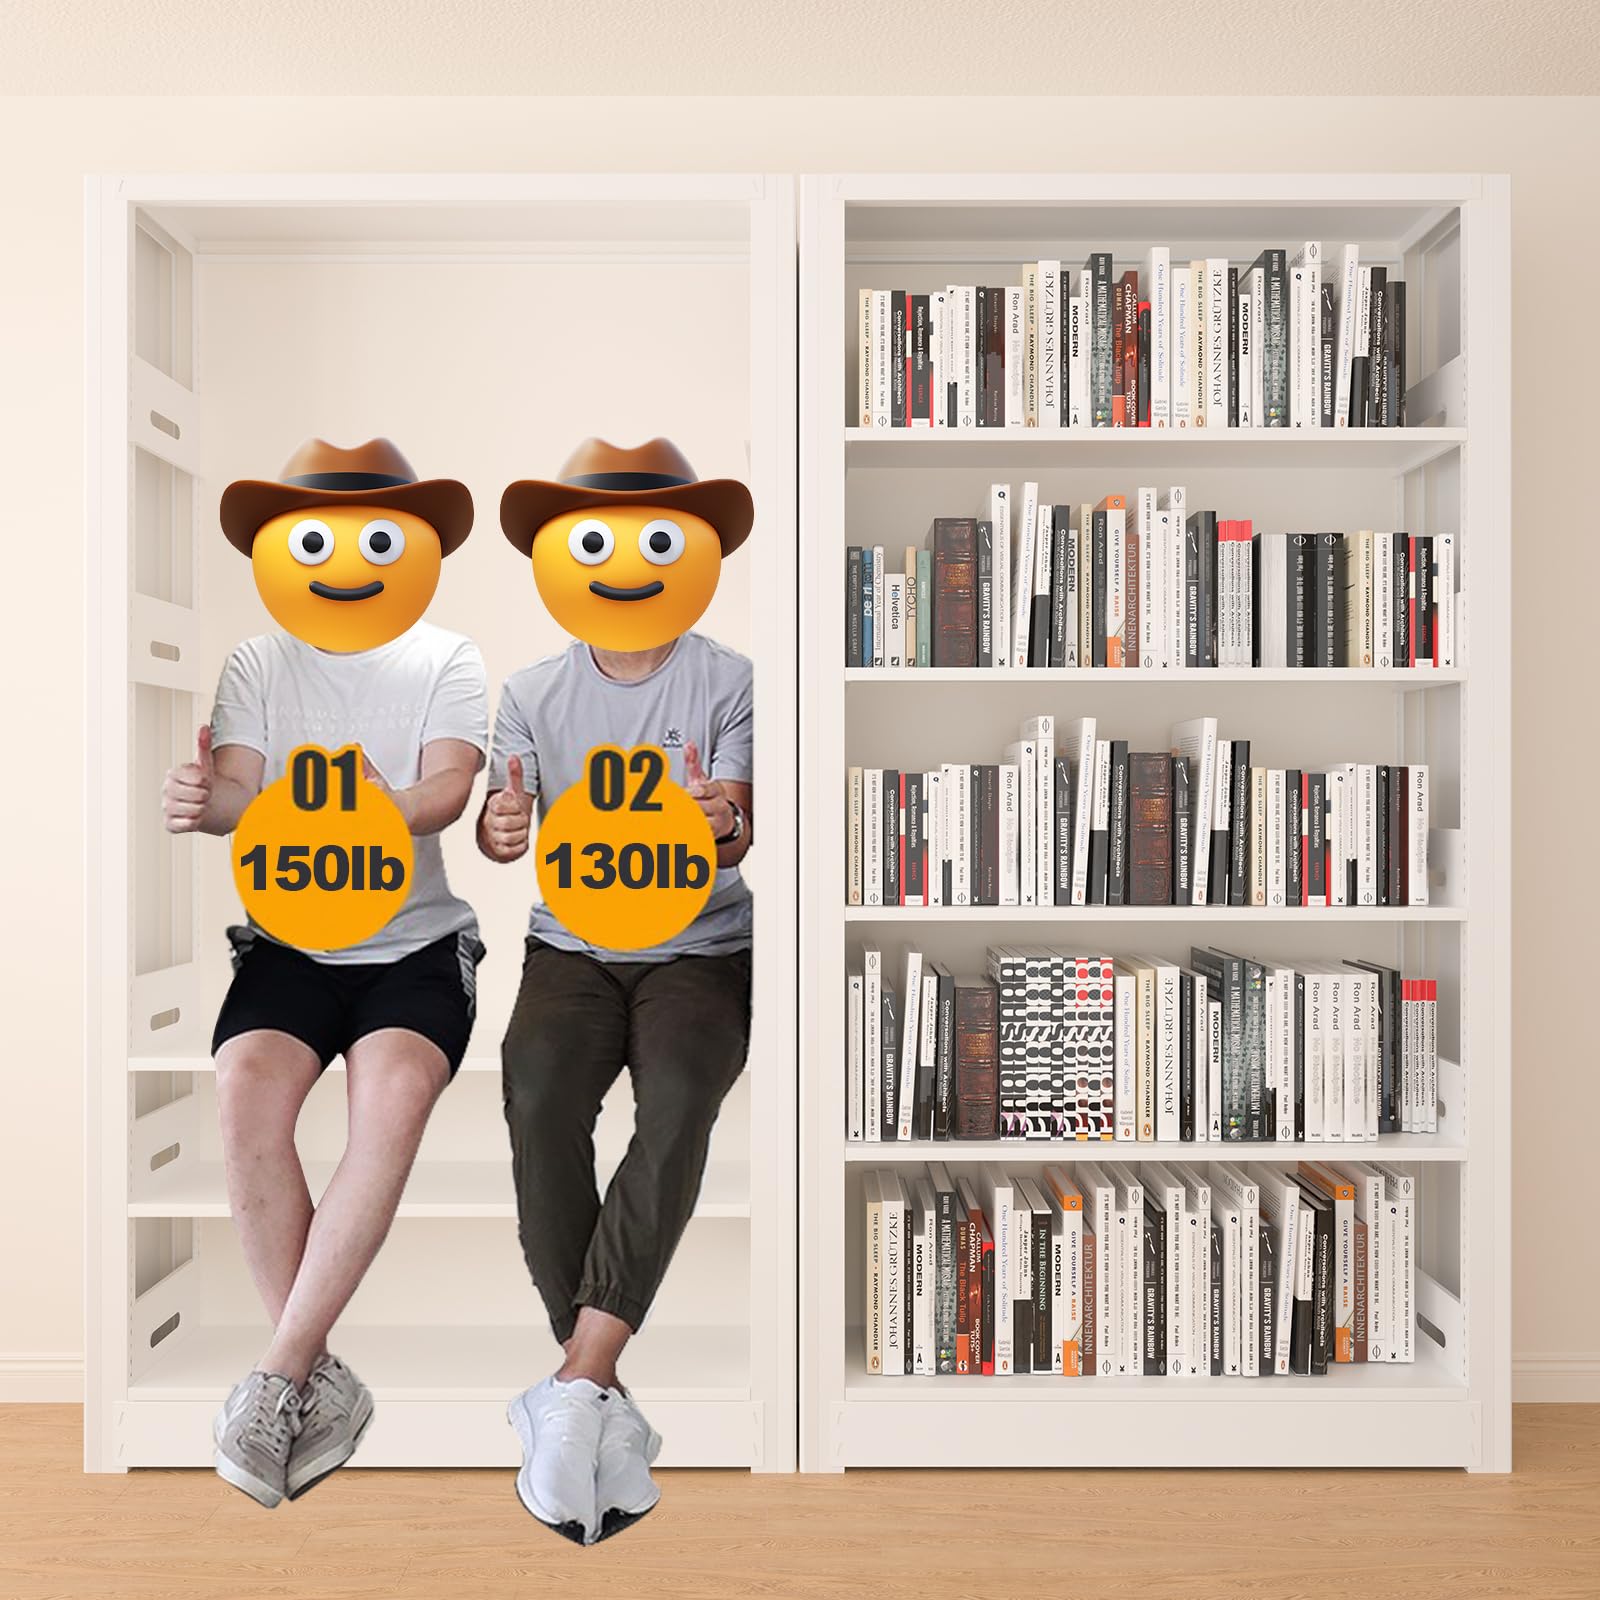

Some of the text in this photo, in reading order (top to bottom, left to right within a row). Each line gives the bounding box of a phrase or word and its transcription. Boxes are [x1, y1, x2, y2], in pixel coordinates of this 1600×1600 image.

[1012, 292, 1020, 334] Ron Arad
[1044, 272, 1055, 409] JOHANNES GRÜTZKE
[1157, 340, 1164, 350] of
[1212, 270, 1222, 408] JOHANNES GRÜTZKE
[1114, 323, 1123, 384] The Black Tulip
[1323, 344, 1332, 416] GRAVITY'S RAINBOW
[891, 584, 901, 630] Helvetica
[906, 576, 916, 620] TYCHO
[982, 582, 991, 654] GRAVITY'S RAINBOW
[1128, 543, 1137, 651] INNENARCHITEKTUR
[1189, 586, 1198, 656] GRAVITY'S RAINBOW
[1060, 818, 1068, 889] GRAVITY'S RAINBOW
[1179, 818, 1188, 889] GRAVITY'S RAINBOW
[1353, 982, 1362, 1030] Ron Arad
[1123, 1058, 1130, 1067] of
[1163, 978, 1174, 1116] JOHANNES GRÜTZKE
[885, 1053, 894, 1125] GRAVITY'S RAINBOW
[888, 1212, 898, 1349] JOHANNES GRÜTZKE
[959, 1262, 967, 1324] The Black Tulip
[1001, 1281, 1009, 1291] of
[1084, 1244, 1094, 1354] INNENARCHITEKTUR
[1356, 1233, 1365, 1342] INNENARCHITEKTUR
[1146, 1288, 1155, 1359] GRAVITY'S RAINBOW
[1263, 1288, 1272, 1359] GRAVITY'S RAINBOW
